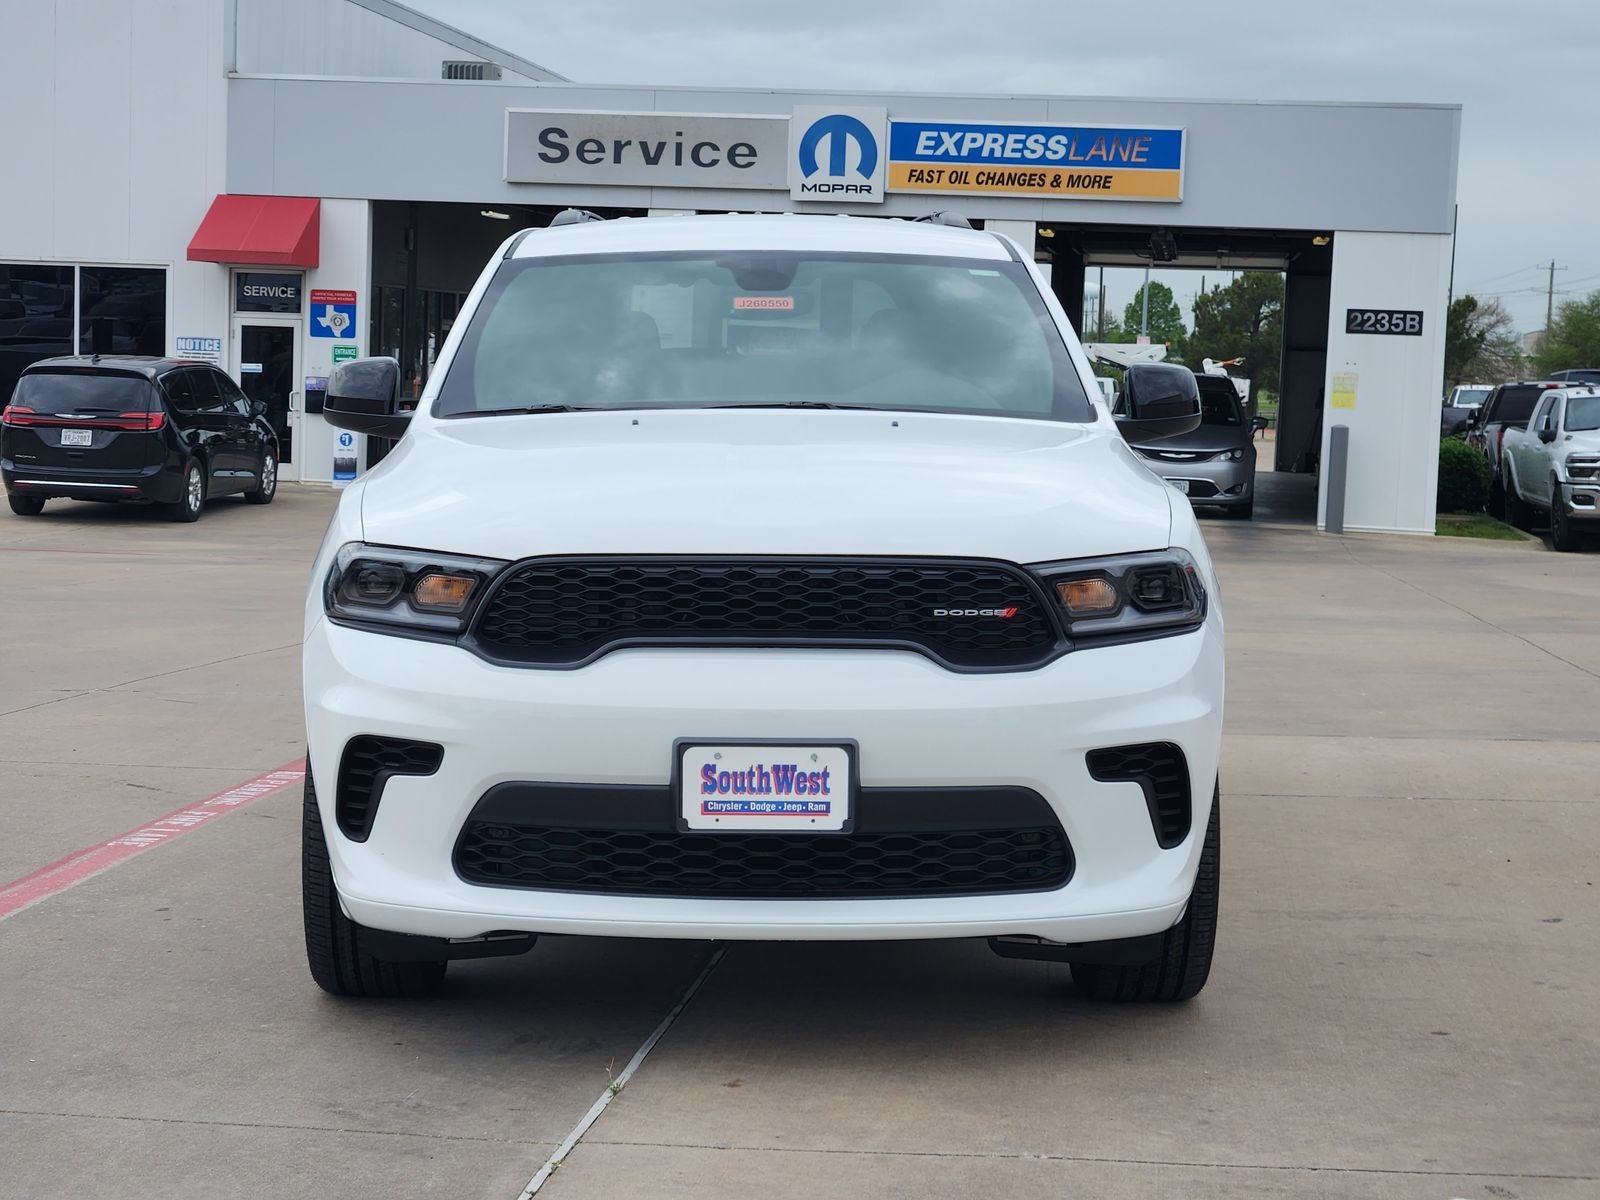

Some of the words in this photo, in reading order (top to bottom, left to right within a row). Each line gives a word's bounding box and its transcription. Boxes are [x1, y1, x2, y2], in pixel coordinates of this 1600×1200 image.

[537, 126, 758, 169] Service
[907, 168, 946, 184] FAST
[948, 170, 971, 185] OIL
[975, 171, 1047, 188] CHANGES
[1050, 174, 1063, 188] &
[1066, 174, 1113, 189] MORE
[801, 183, 873, 194] MOPAR
[243, 285, 295, 298] SERVICE
[738, 299, 789, 308] J260550
[1350, 312, 1420, 332] 2235B
[177, 338, 220, 351] NOTICE
[701, 763, 830, 795] SouthWest
[708, 801, 743, 812] Chrysler
[750, 802, 776, 812] Dodge
[783, 802, 802, 813] Jeep
[808, 802, 826, 811] Ram
